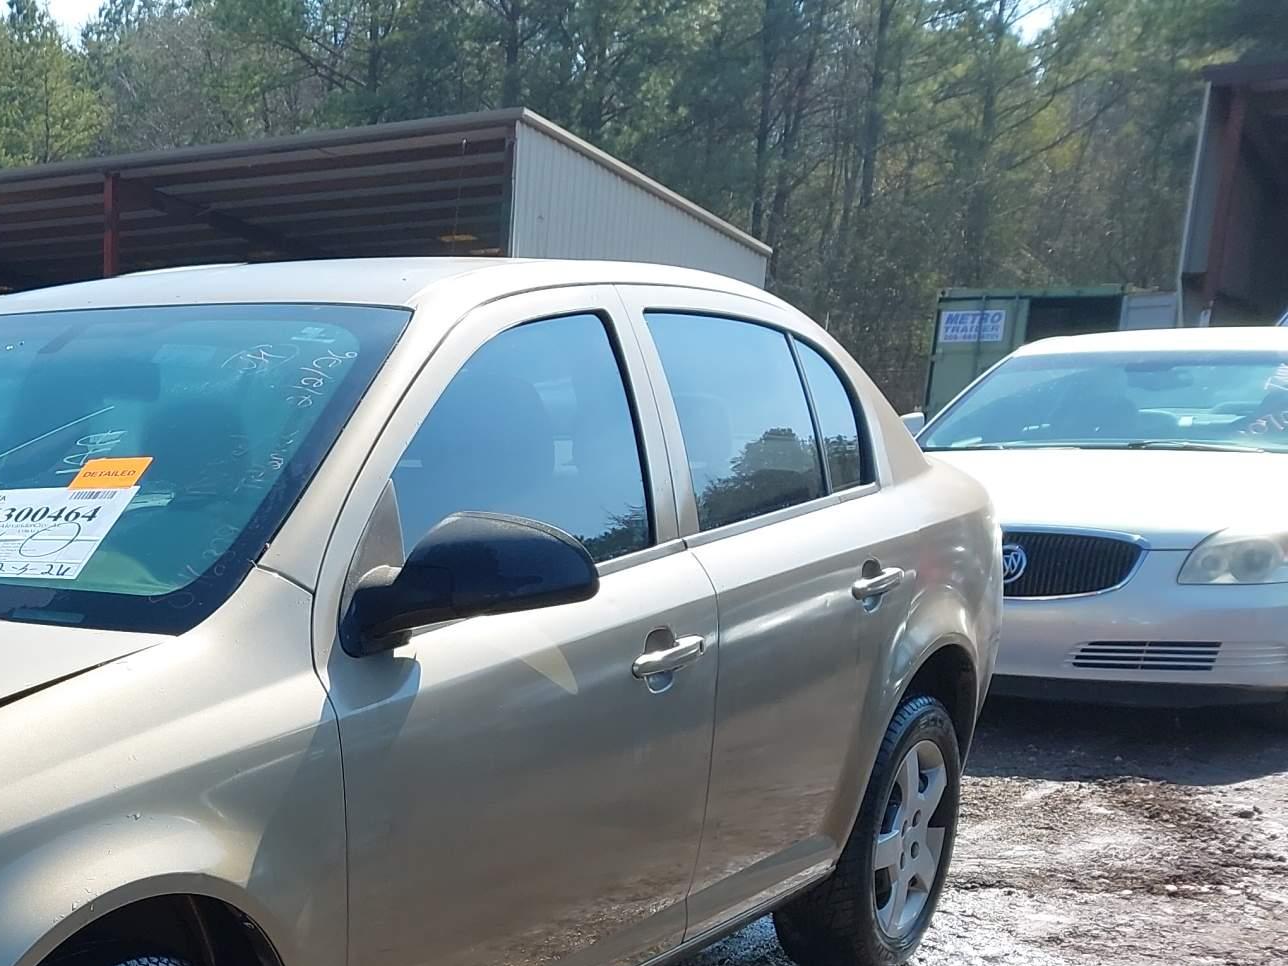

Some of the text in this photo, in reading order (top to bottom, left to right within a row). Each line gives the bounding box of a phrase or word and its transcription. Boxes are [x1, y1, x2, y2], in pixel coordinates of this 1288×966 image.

[945, 312, 1002, 325] METRO
[943, 325, 1000, 334] TRAILER
[82, 469, 137, 479] DETAILED
